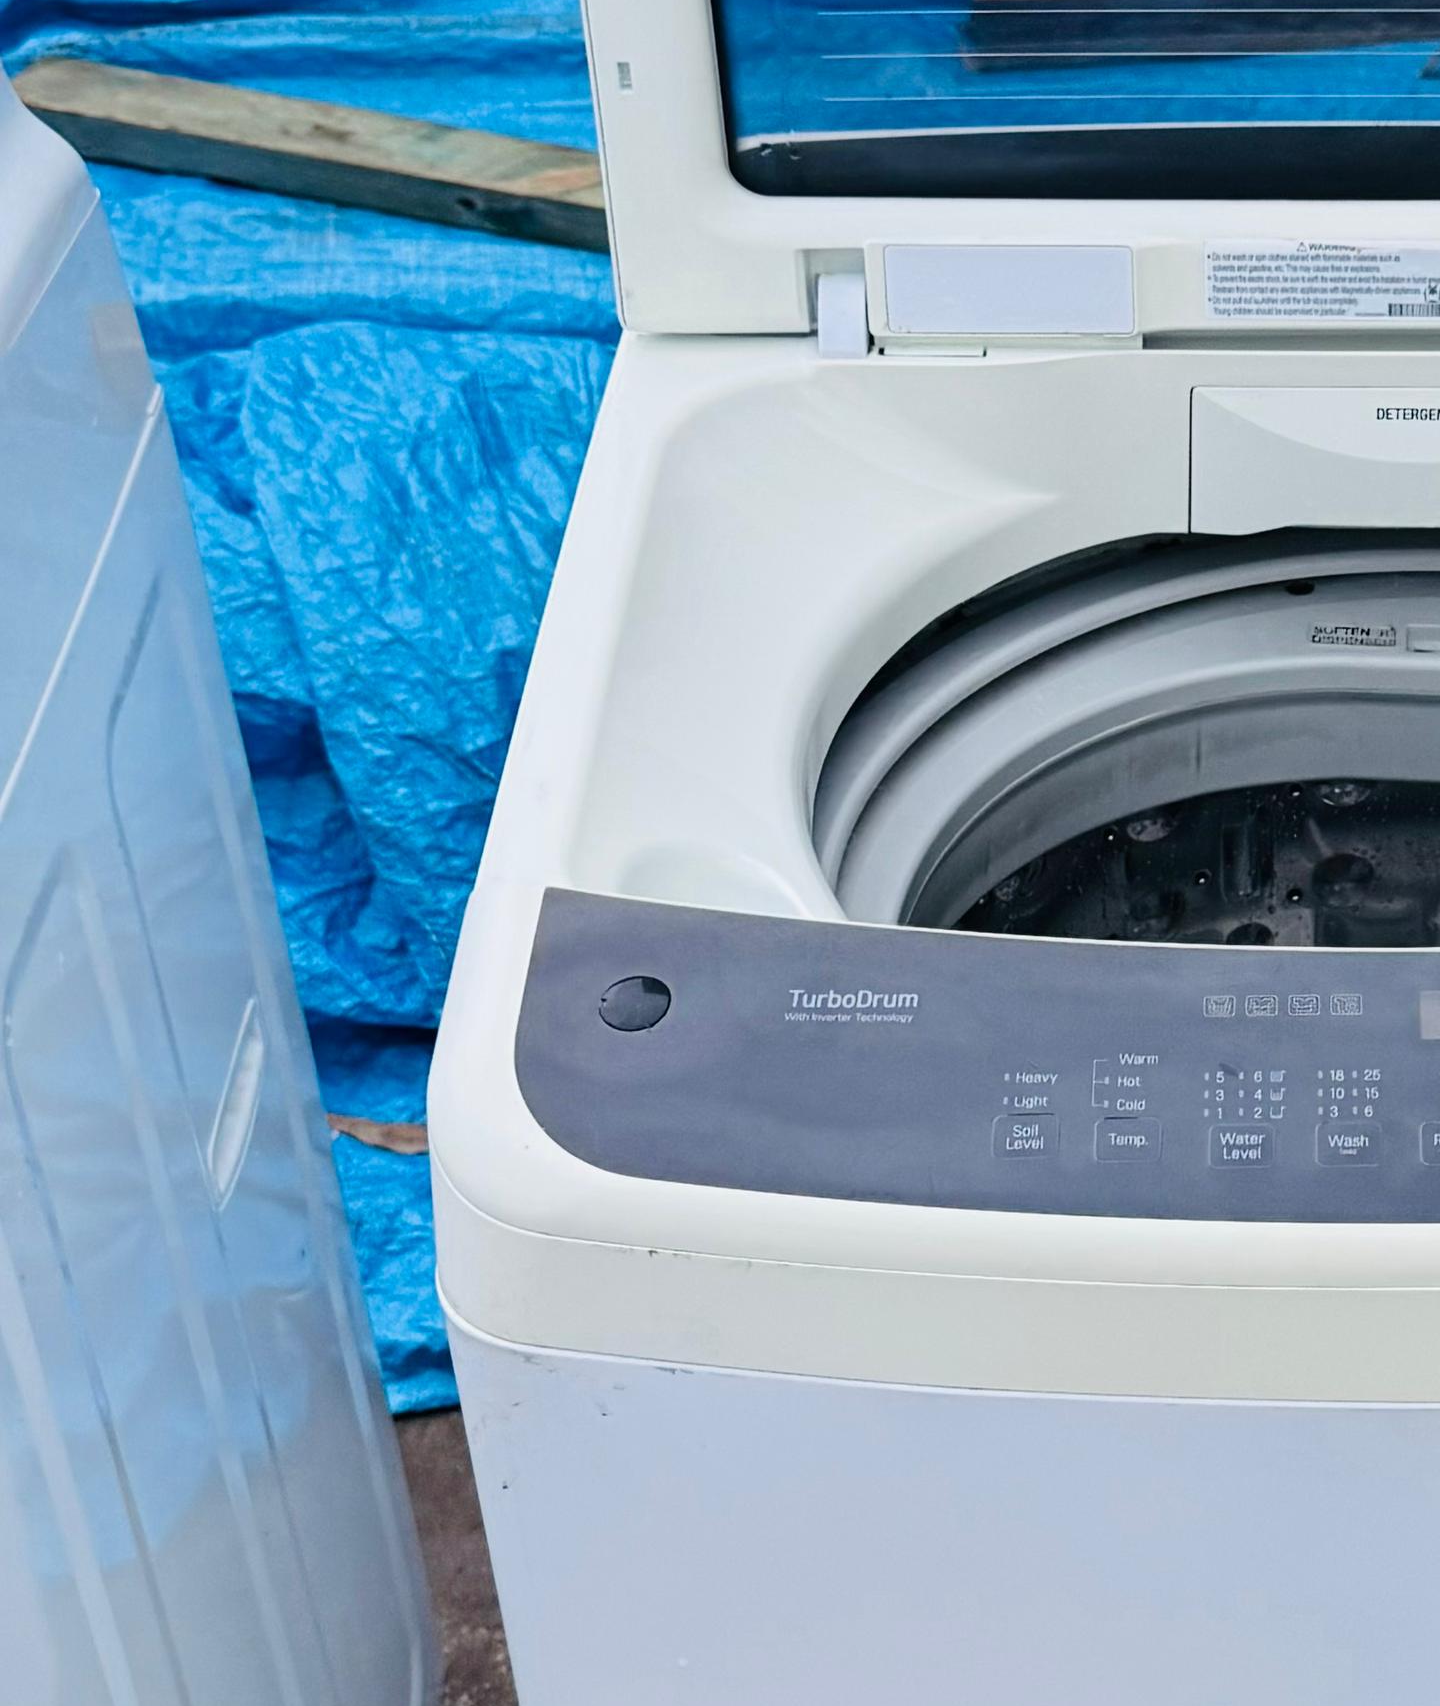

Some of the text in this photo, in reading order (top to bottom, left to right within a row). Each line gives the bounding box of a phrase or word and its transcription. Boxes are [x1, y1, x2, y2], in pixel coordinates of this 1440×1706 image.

[788, 989, 919, 1009] TurboDrum
[784, 1012, 913, 1024] With Inverter Technology
[1119, 1052, 1159, 1065] Warm
[1016, 1072, 1058, 1085] Heavy
[1117, 1075, 1140, 1087] Hot
[1215, 1070, 1225, 1083] 5
[1253, 1070, 1263, 1082] 6
[1329, 1069, 1344, 1081] 18
[1363, 1069, 1381, 1081] 25
[1215, 1089, 1225, 1101] 3
[1253, 1089, 1262, 1101] 4
[1329, 1088, 1345, 1100] 10
[1364, 1088, 1379, 1100] 15
[1014, 1095, 1048, 1110] Light
[1116, 1099, 1145, 1111] Cold
[1253, 1107, 1263, 1119] 2
[1330, 1106, 1339, 1118] 3
[1363, 1106, 1373, 1118] 6
[1012, 1124, 1039, 1137] Soil
[1006, 1136, 1044, 1150] Level
[1108, 1132, 1149, 1148] Temp.
[1220, 1132, 1265, 1145] Water
[1328, 1134, 1369, 1148] Wash
[1223, 1146, 1262, 1160] Level
